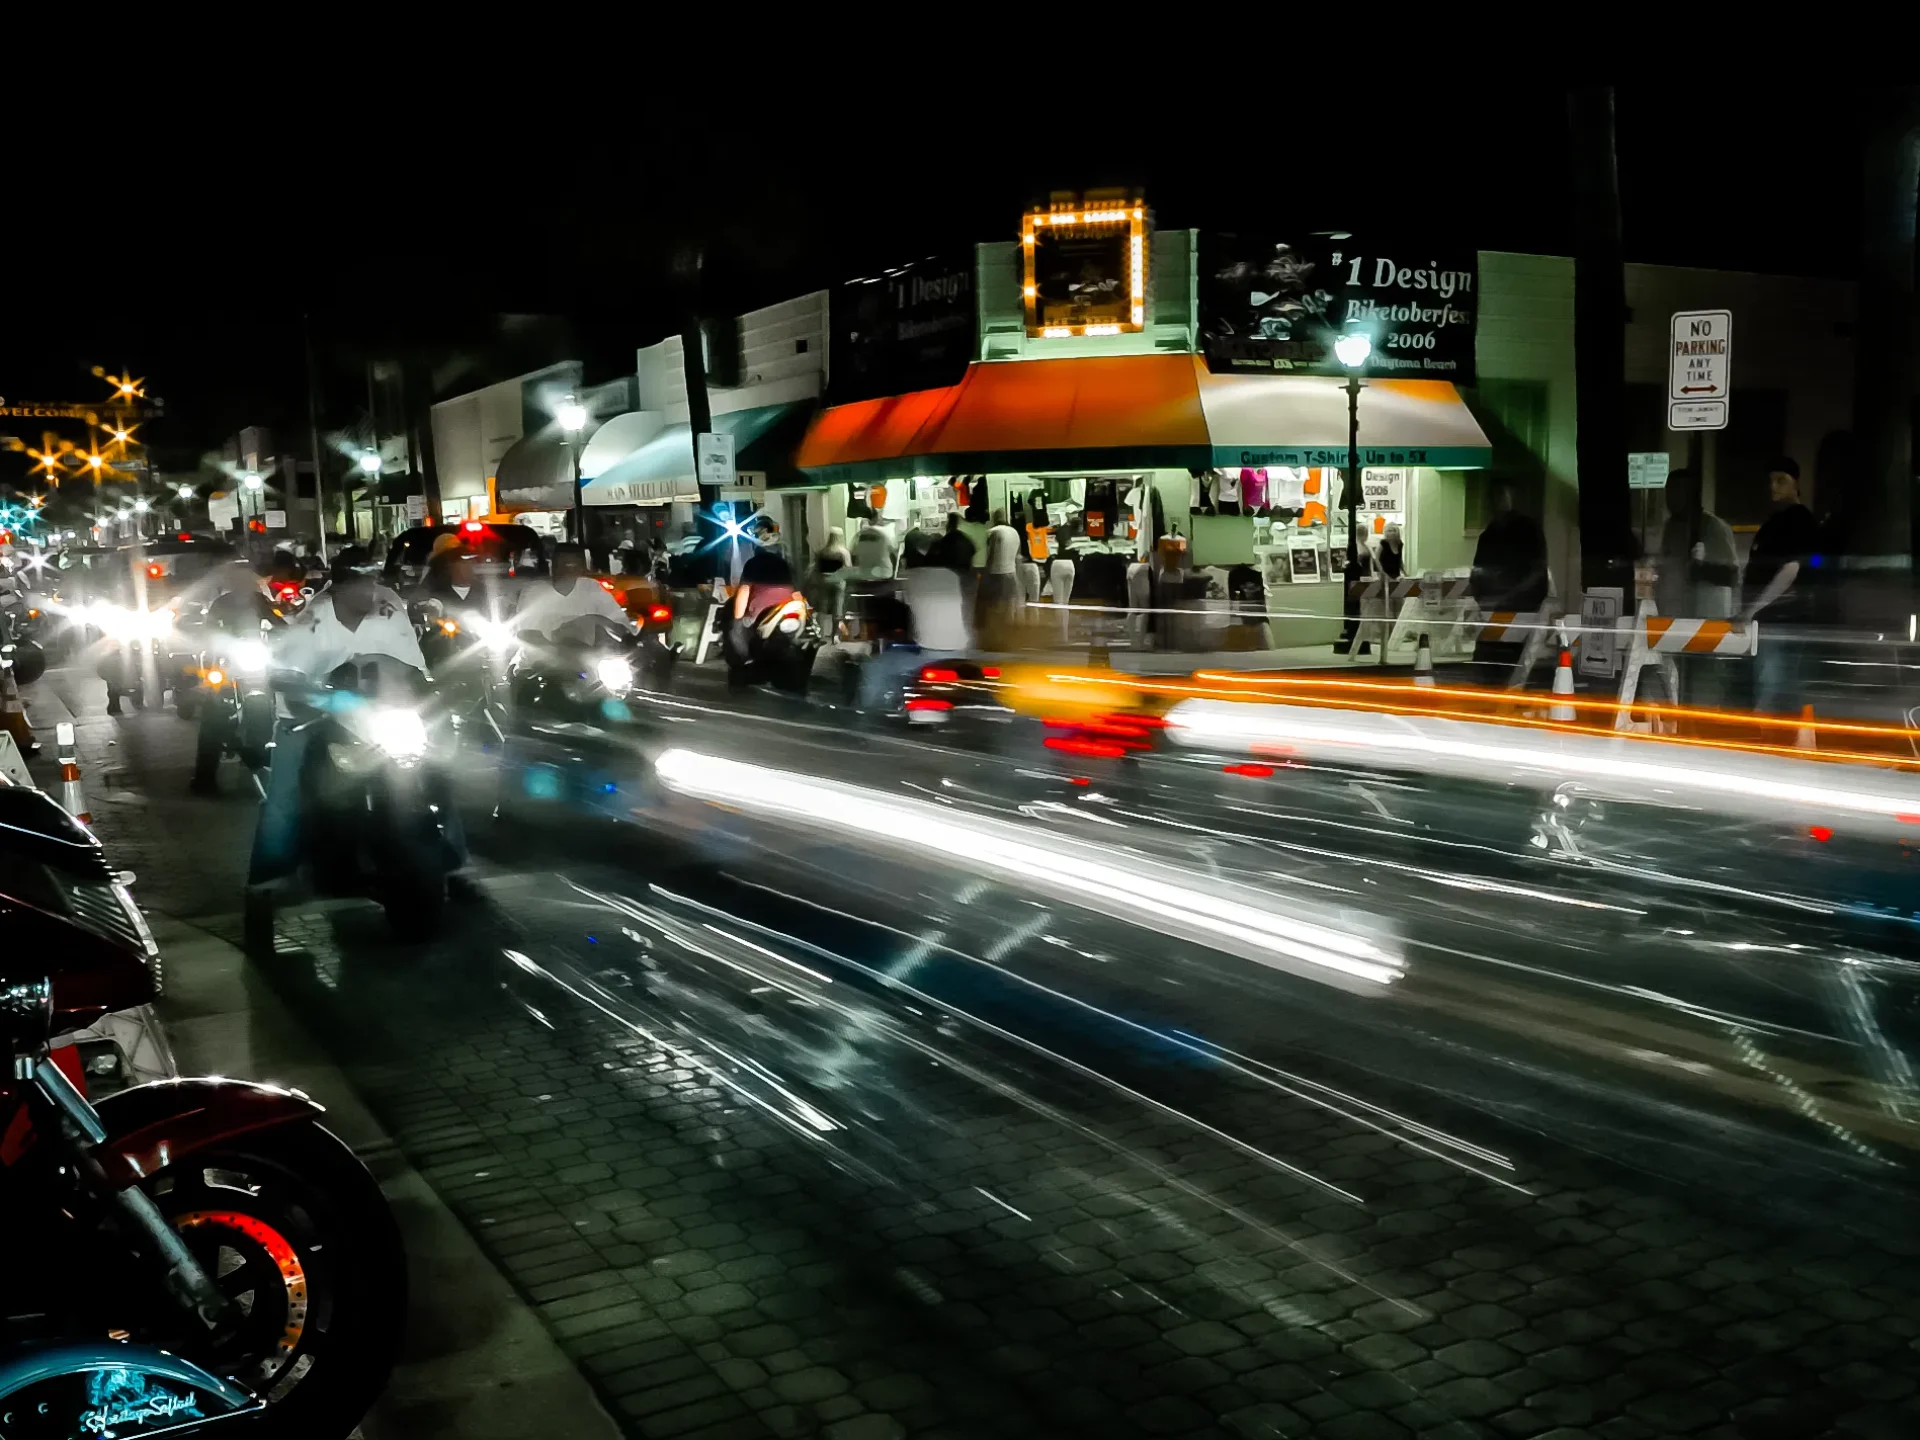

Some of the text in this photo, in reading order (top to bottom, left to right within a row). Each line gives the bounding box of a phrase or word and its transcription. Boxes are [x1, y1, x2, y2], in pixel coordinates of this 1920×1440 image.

[1373, 257, 1472, 298] Design
[911, 268, 970, 304] Design
[1690, 321, 1712, 337] NO
[1387, 330, 1437, 350] 2006
[1675, 339, 1726, 357] PARKING
[1371, 355, 1422, 370] Daytona
[1688, 358, 1712, 369] ANY
[1686, 371, 1713, 382] TIME
[1240, 450, 1428, 466] Custom T-Shirs Up to 5X
[1366, 471, 1400, 484] Design
[1370, 499, 1396, 510] HERE
